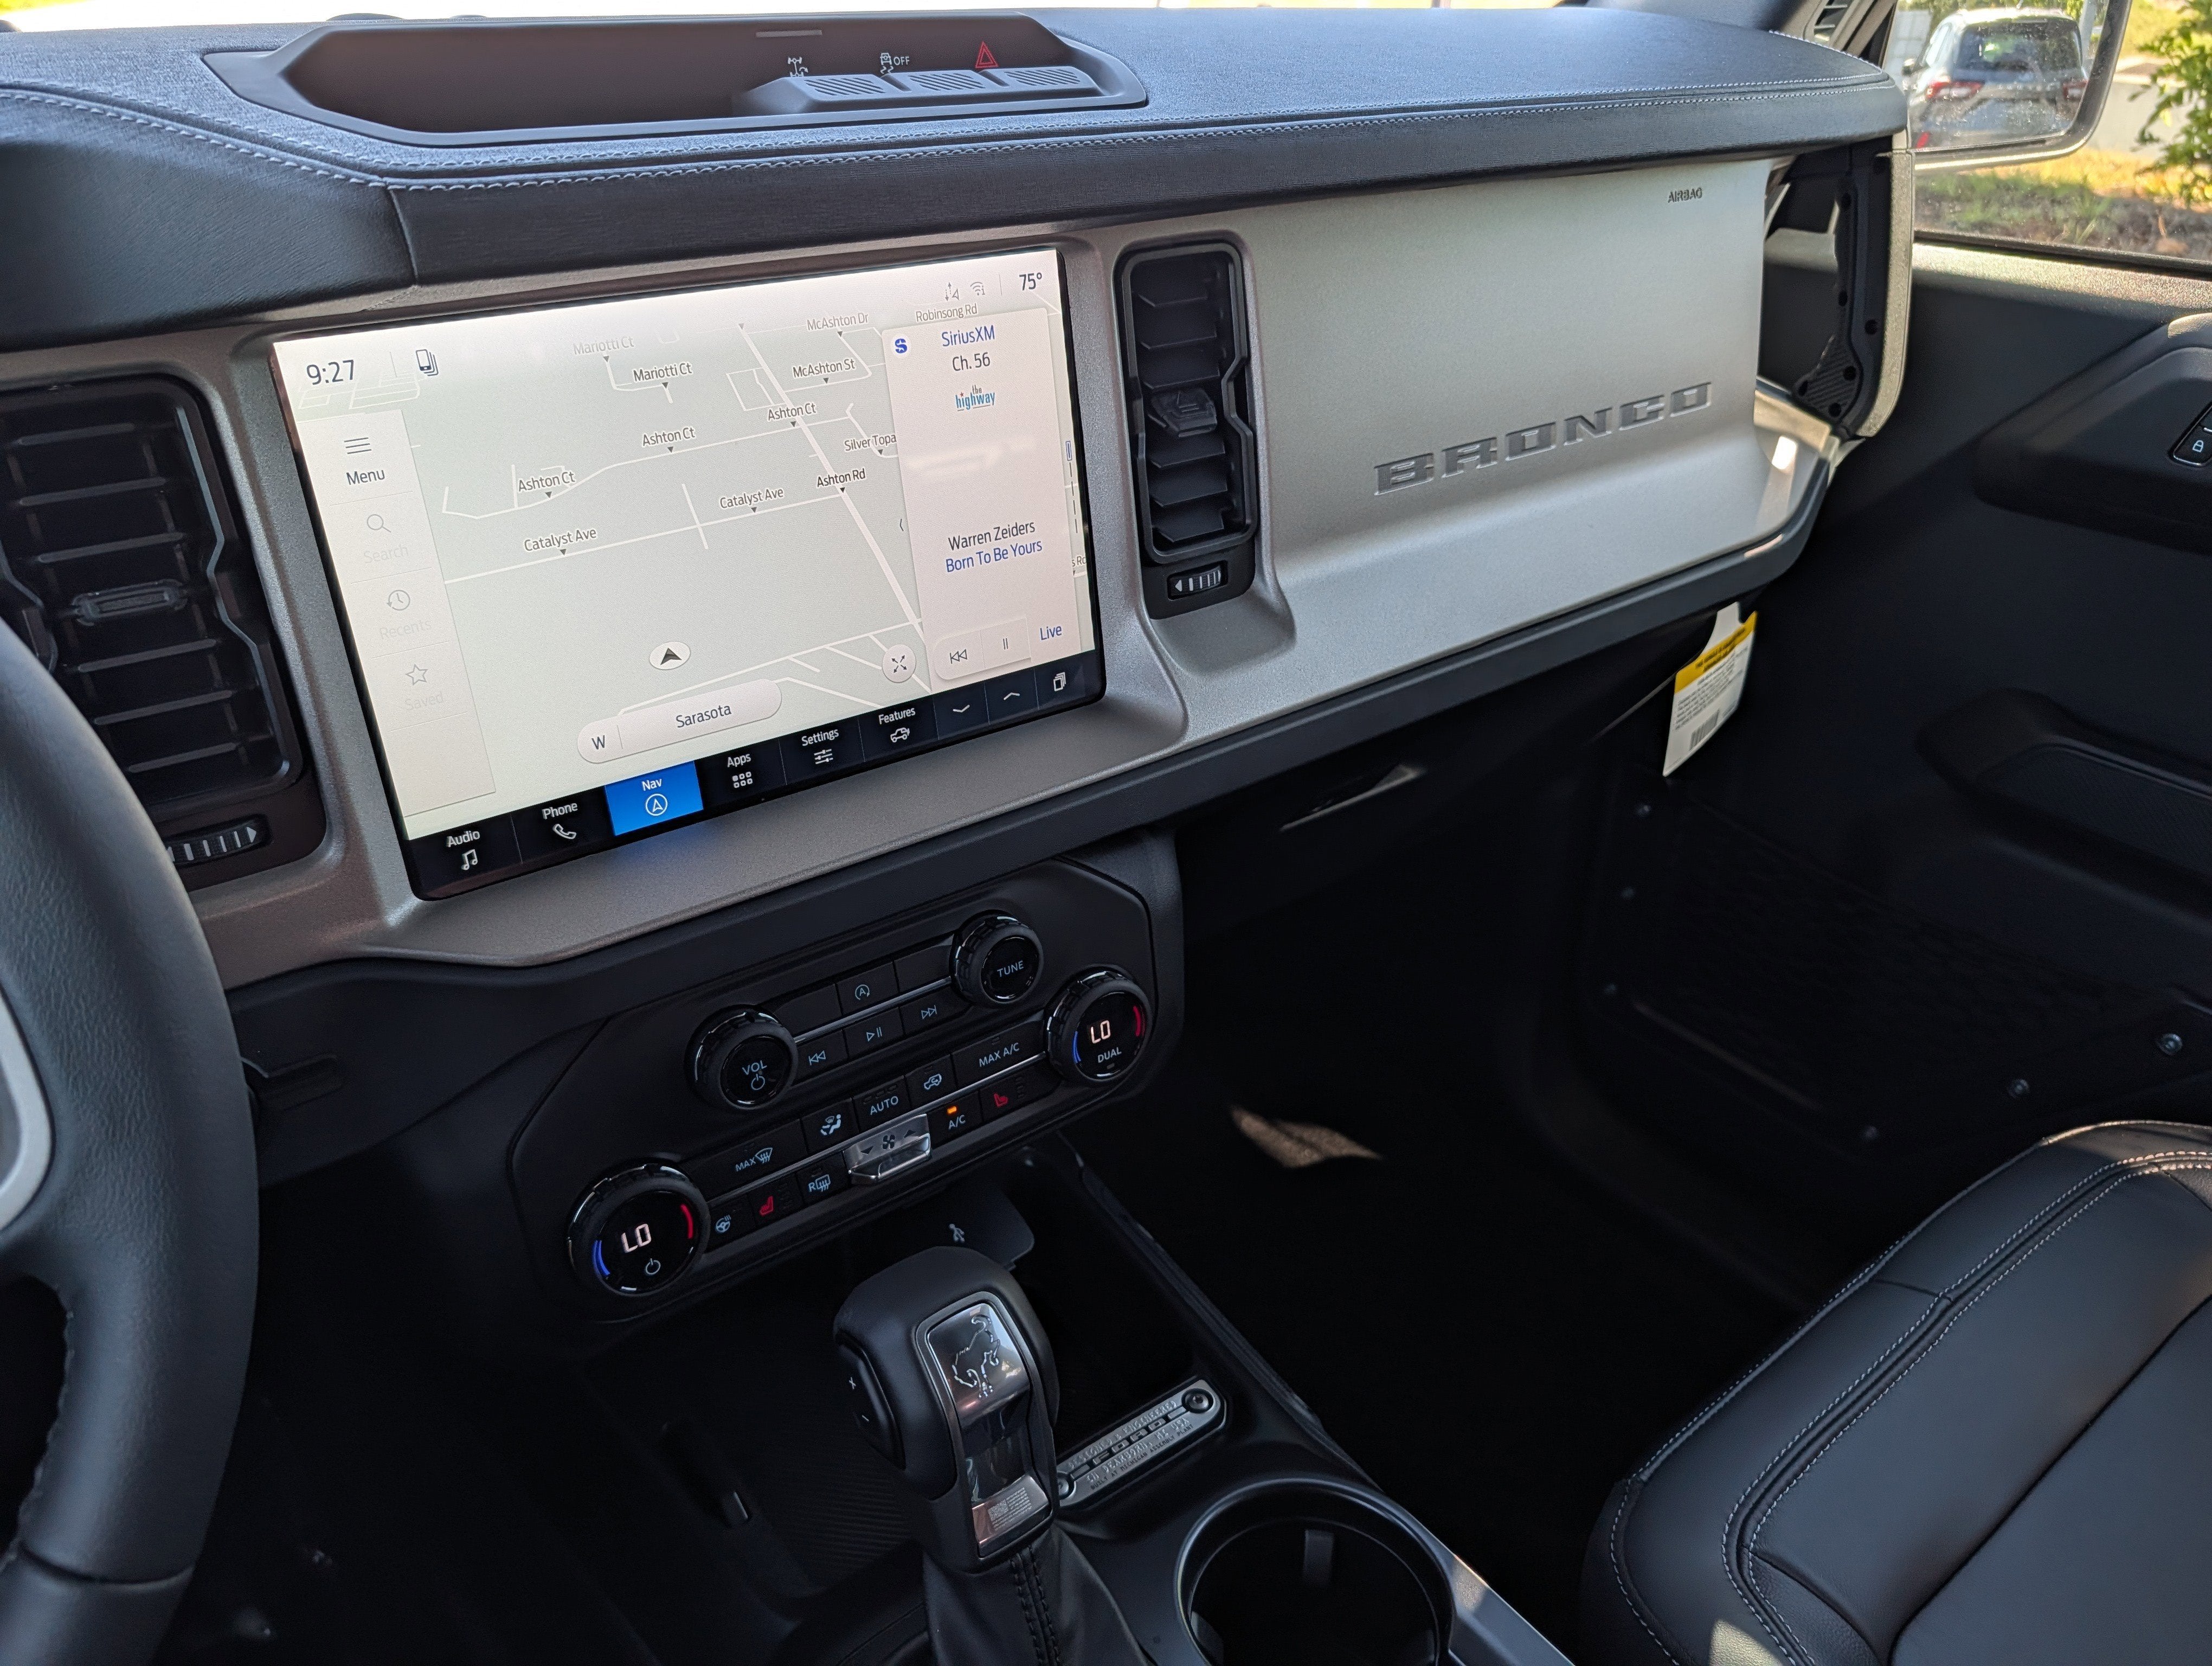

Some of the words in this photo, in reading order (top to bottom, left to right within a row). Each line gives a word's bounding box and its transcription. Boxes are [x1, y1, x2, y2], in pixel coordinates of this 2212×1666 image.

[893, 56, 910, 66] OFF
[1019, 272, 1043, 290] 75°
[916, 307, 963, 322] Robinsong
[965, 303, 977, 315] Rd
[807, 315, 855, 331] McAshton
[857, 313, 869, 324] Dr
[942, 325, 995, 347] SiriusXM
[573, 339, 619, 355] Mariotti
[620, 336, 634, 348] Ct
[793, 362, 842, 377] McAshton
[844, 359, 855, 370] St
[952, 355, 972, 371] Ch.
[974, 352, 991, 368] 56
[306, 360, 355, 385] 9:27
[633, 364, 678, 381] Mariotti
[679, 363, 692, 375] Ct
[972, 385, 982, 394] the
[955, 392, 995, 409] highway
[768, 406, 803, 421] Ashton
[805, 403, 816, 414] Ct
[642, 431, 681, 446] Ashton
[682, 428, 695, 439] Ct
[845, 439, 870, 452] Silver
[1374, 382, 1712, 495] BRONCO
[346, 469, 385, 485] Menu
[518, 475, 560, 492] Ashton
[562, 471, 575, 484] Ct
[817, 472, 851, 488] Ashton
[852, 469, 866, 480] Rd
[720, 491, 763, 509] Catalyst
[765, 489, 783, 501] Ave
[524, 533, 573, 552] Catalyst
[576, 529, 597, 542] Ave
[948, 530, 992, 550] Warren
[993, 521, 1035, 541] Zeiders
[364, 544, 409, 564] Search
[946, 556, 974, 573] Born
[975, 551, 991, 565] To
[993, 547, 1008, 561] Be
[1010, 541, 1043, 557] Yours
[381, 620, 431, 639] Recents
[1040, 625, 1062, 640] Live
[404, 692, 443, 710] Saved
[676, 705, 731, 728] Sarasota
[878, 707, 915, 725] Features
[591, 735, 606, 749] W
[801, 728, 839, 747] Settings
[727, 753, 751, 768] Apps
[641, 778, 662, 791] Nav
[542, 802, 578, 819] Phone
[446, 830, 480, 848] Audio
[998, 960, 1024, 977] TUNE
[1090, 1020, 1111, 1044] LO
[979, 1051, 1001, 1067] MAX
[1002, 1042, 1020, 1058] A/C
[1097, 1047, 1122, 1063] DUAL
[742, 1061, 767, 1075] VOL
[870, 1096, 899, 1116] AUTO
[948, 1115, 966, 1130] A/C
[735, 1158, 755, 1171] MAX
[621, 1223, 652, 1254] LO
[1092, 1418, 1166, 1465] FORD
[1149, 1435, 1175, 1453] ASSEMBLY
[1177, 1424, 1194, 1436] PLANT
